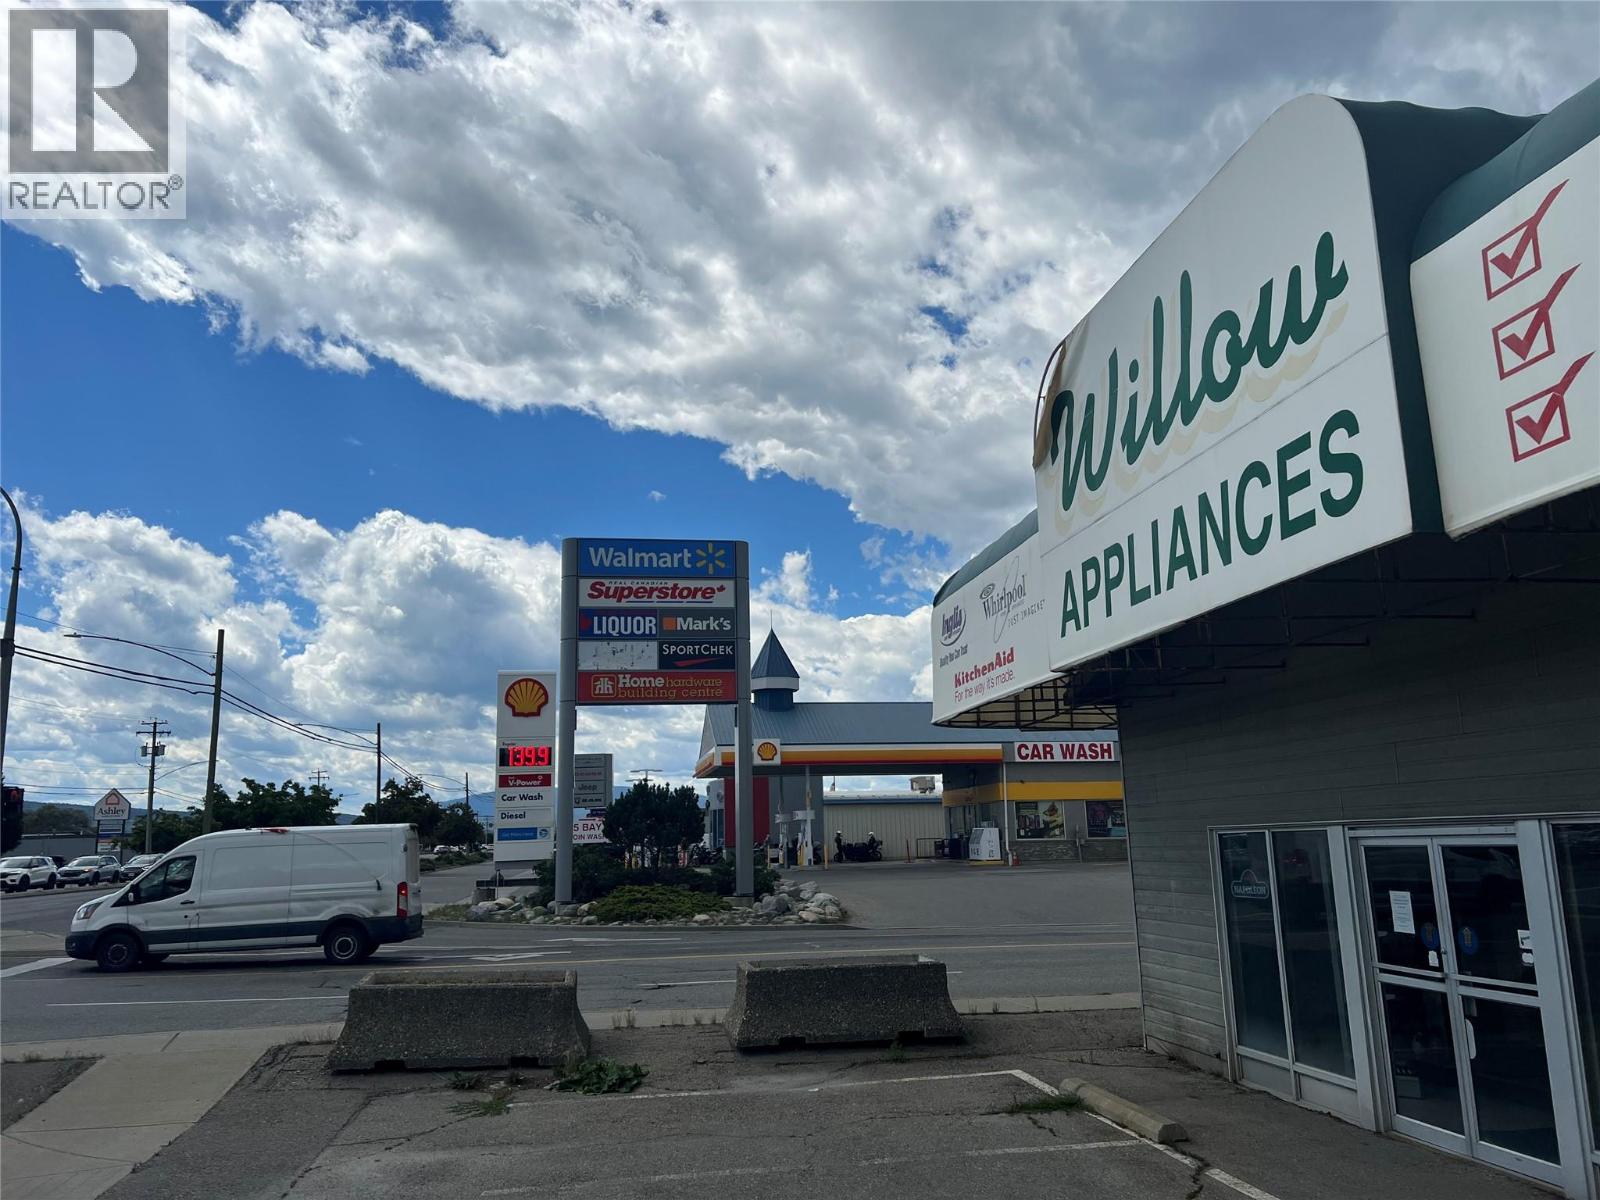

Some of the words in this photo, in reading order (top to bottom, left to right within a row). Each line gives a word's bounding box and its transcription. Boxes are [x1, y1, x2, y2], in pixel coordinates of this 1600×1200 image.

[1050, 231, 1349, 511] Willow
[1060, 409, 1364, 638] APPLIANCES
[589, 546, 692, 569] Walmart
[587, 581, 716, 603] Superstore
[983, 574, 1026, 620] Whirlpool
[593, 616, 657, 636] LIQUOR
[676, 617, 732, 631] Mark's
[662, 644, 734, 655] SPORTCHEK
[954, 647, 1015, 688] KitchenAid
[618, 673, 664, 688] Home
[667, 676, 722, 687] hardware
[618, 688, 676, 699] building
[682, 687, 723, 697] centre
[954, 690, 964, 703] For
[964, 686, 973, 699] the
[974, 682, 986, 696] way
[1017, 743, 1054, 760] CAR
[1059, 743, 1112, 760] WASH
[519, 793, 543, 801] Wash
[98, 806, 126, 816] Ashley
[501, 811, 526, 820] Diesel
[583, 823, 602, 832] BAY
[1233, 885, 1266, 895] NAPOLEON
